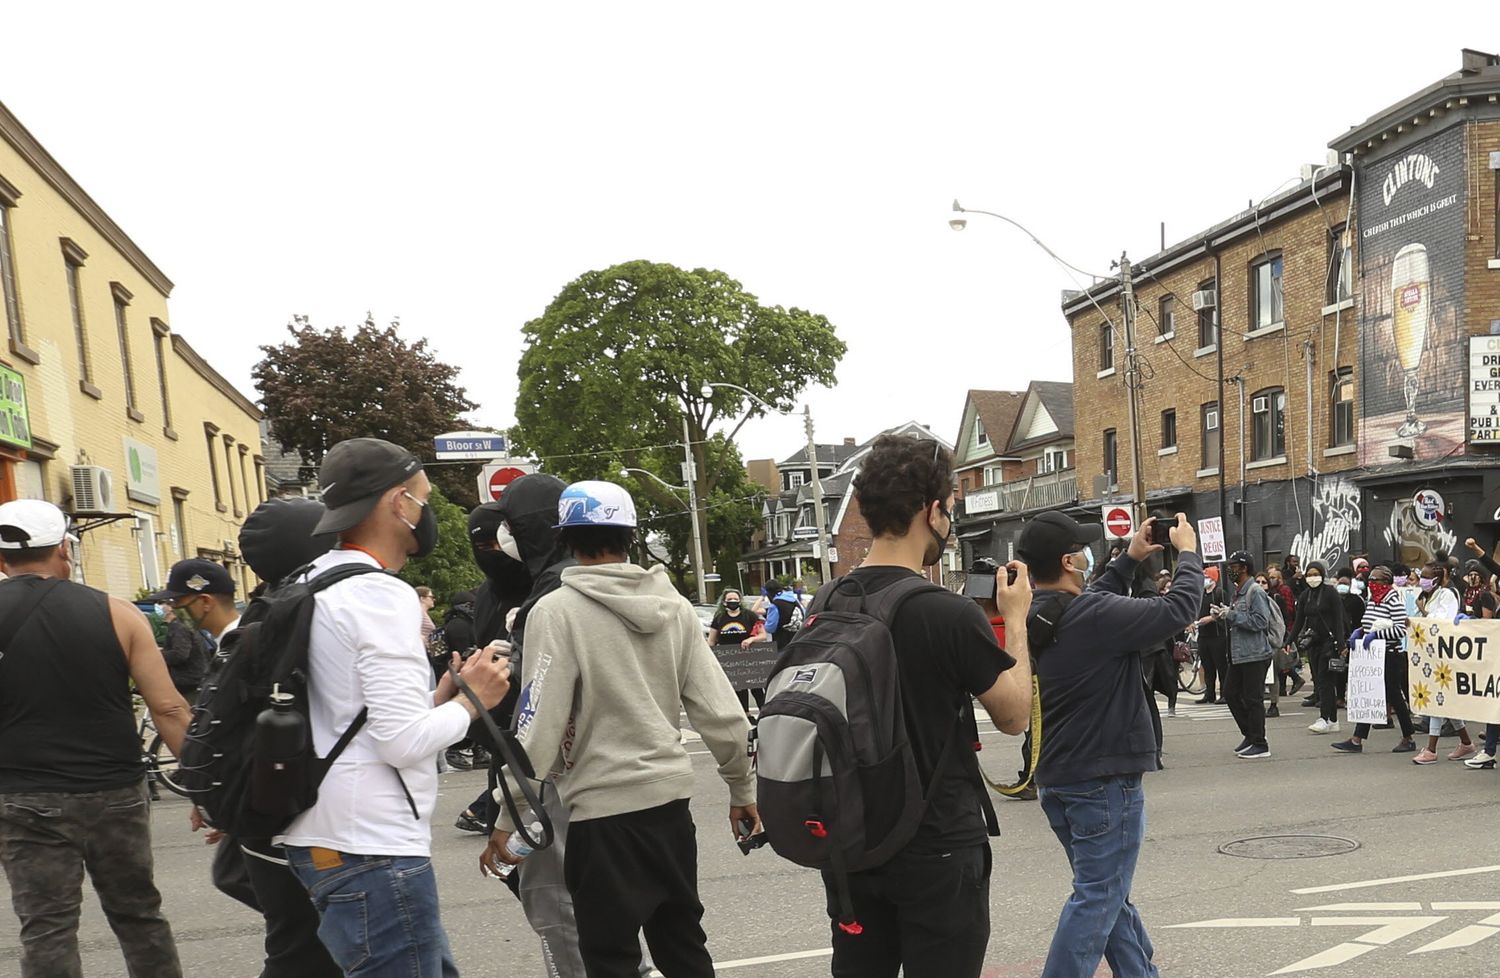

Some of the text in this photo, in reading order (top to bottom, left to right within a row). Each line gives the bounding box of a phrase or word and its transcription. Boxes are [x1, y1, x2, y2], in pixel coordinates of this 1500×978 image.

[1490, 404, 1497, 415] &
[1470, 417, 1492, 428] PUB
[446, 440, 473, 450] Bloor
[483, 440, 491, 449] W
[1200, 520, 1221, 534] JUSTICE
[1203, 541, 1223, 554] REGIS
[1438, 636, 1487, 660] NOT
[519, 714, 534, 740] LITTL
